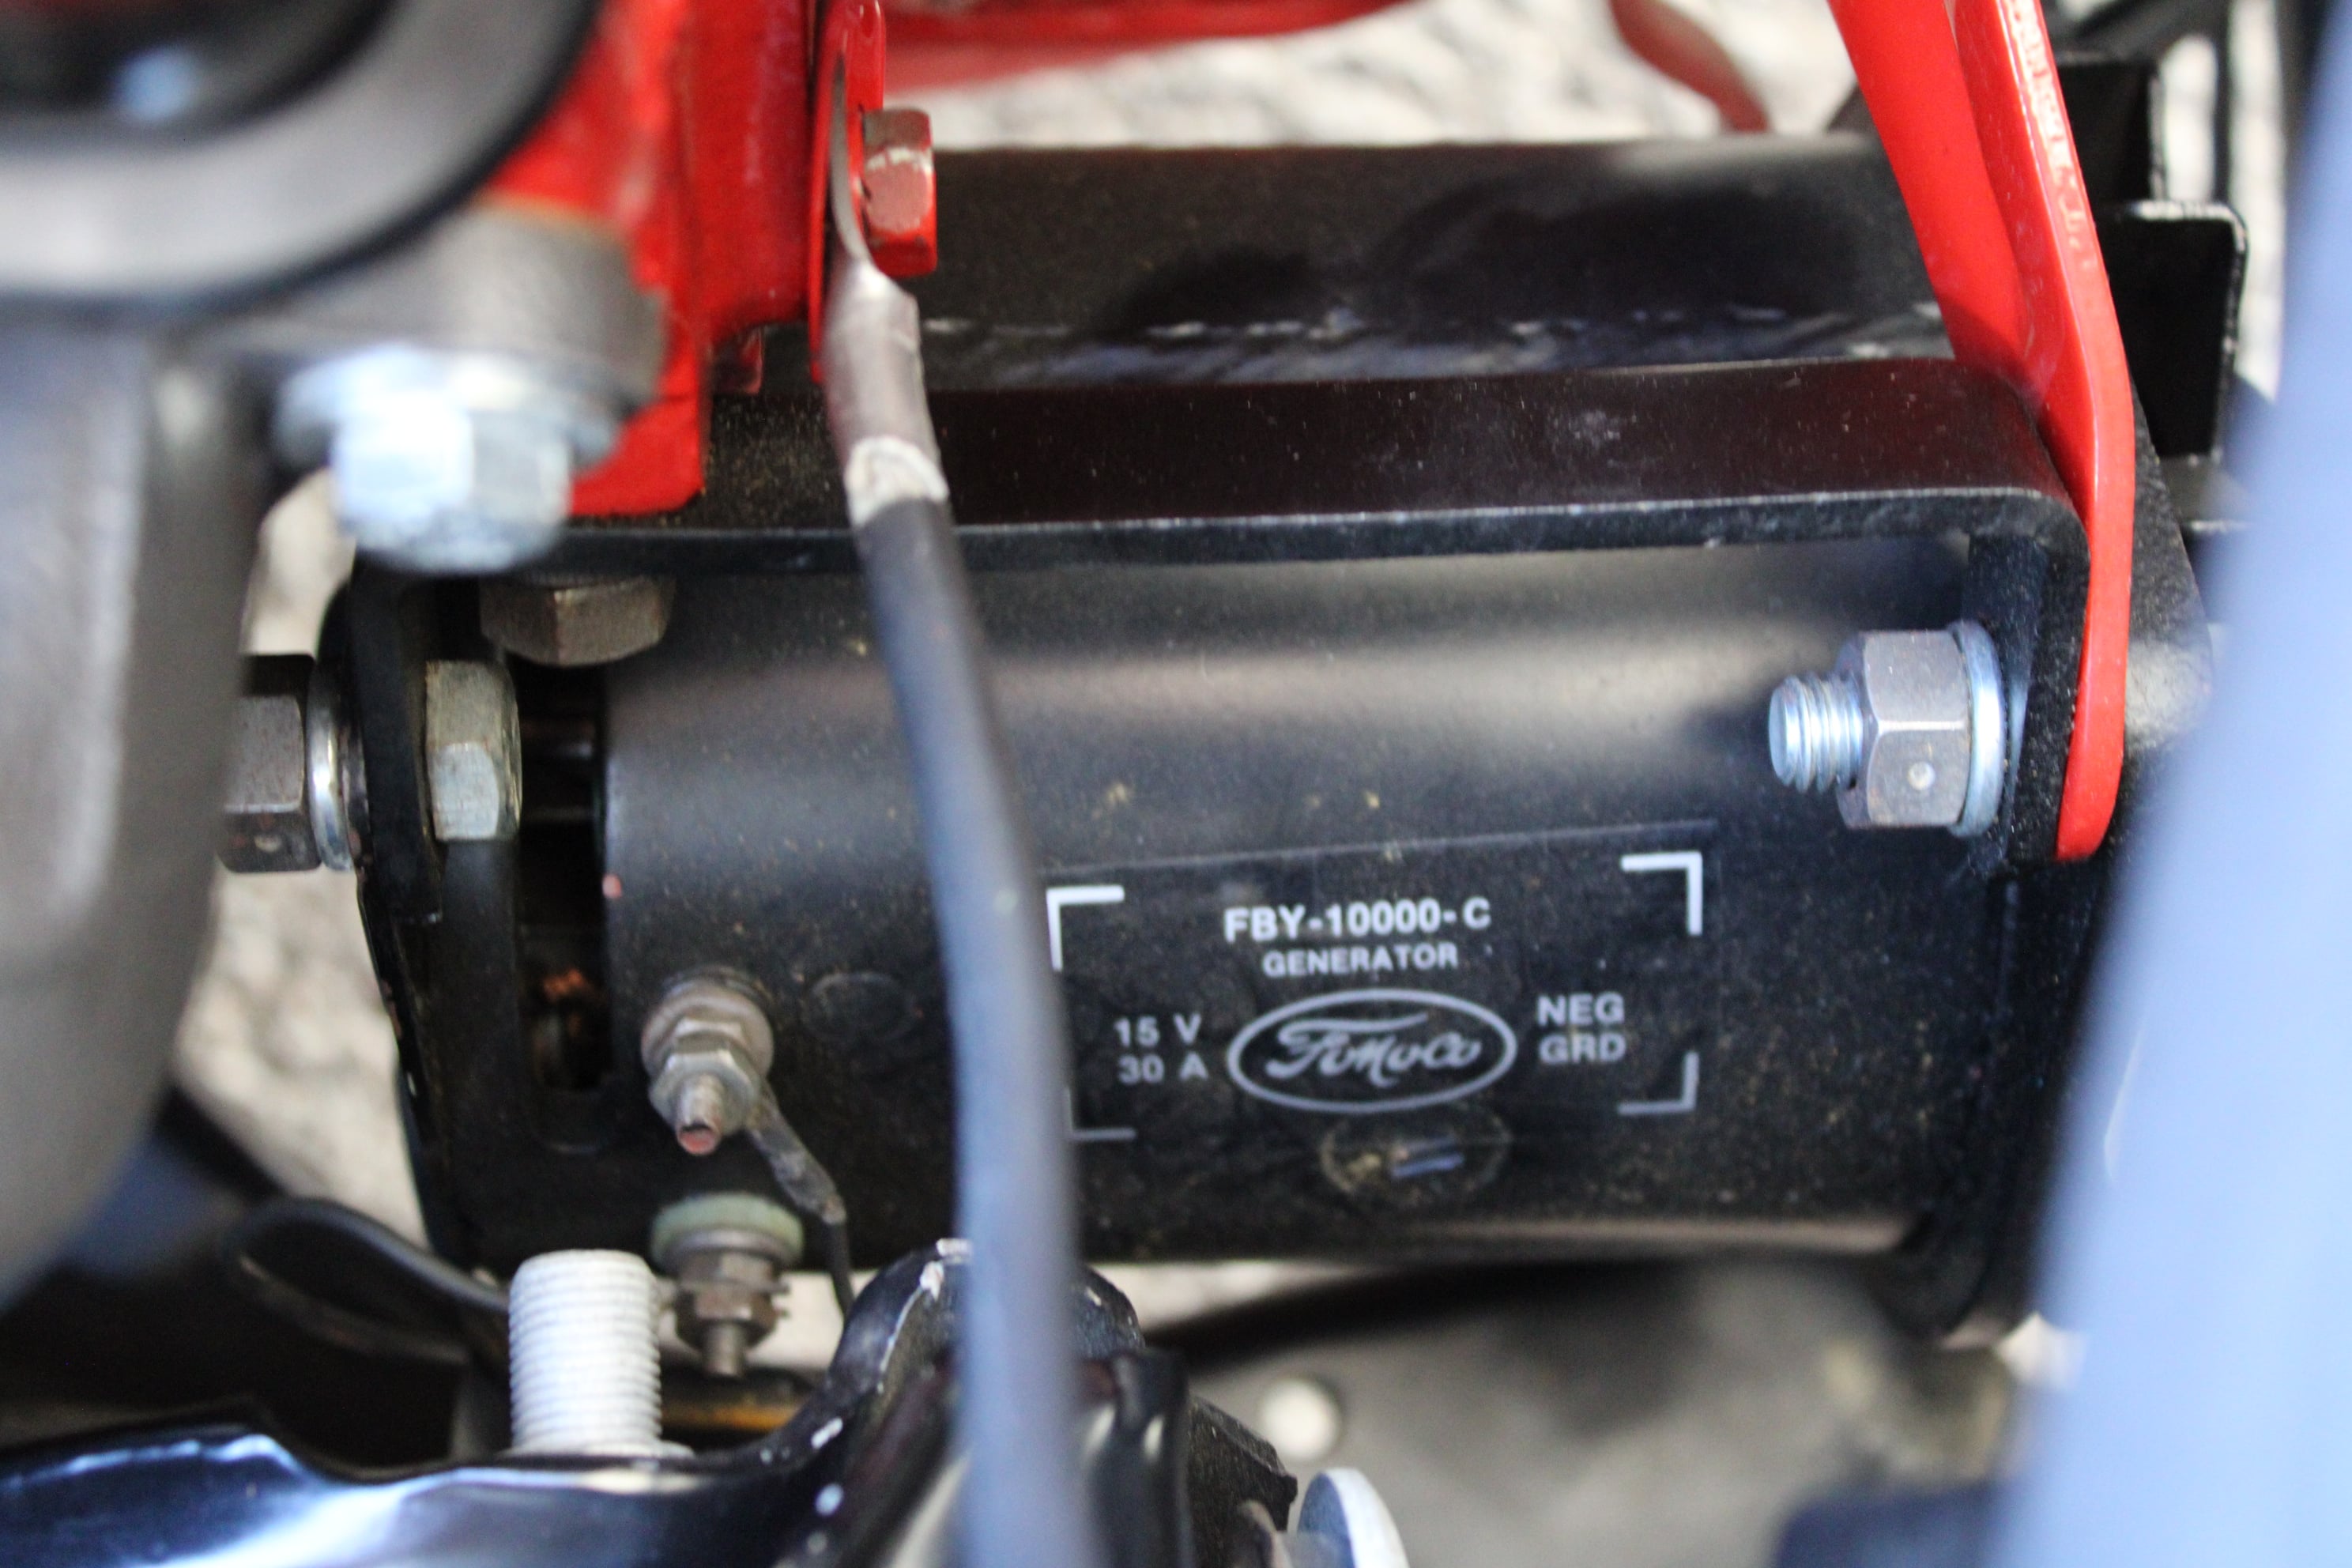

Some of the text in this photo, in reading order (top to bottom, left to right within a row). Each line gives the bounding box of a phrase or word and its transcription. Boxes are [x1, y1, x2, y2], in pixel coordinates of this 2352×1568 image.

[1224, 897, 1492, 943] FBY-10000-C
[1262, 943, 1459, 978] GENERATOR
[1537, 992, 1625, 1027] NEG
[1114, 1014, 1202, 1046] 15 V
[1539, 1033, 1626, 1064] GRD
[1118, 1053, 1209, 1084] 30 A
